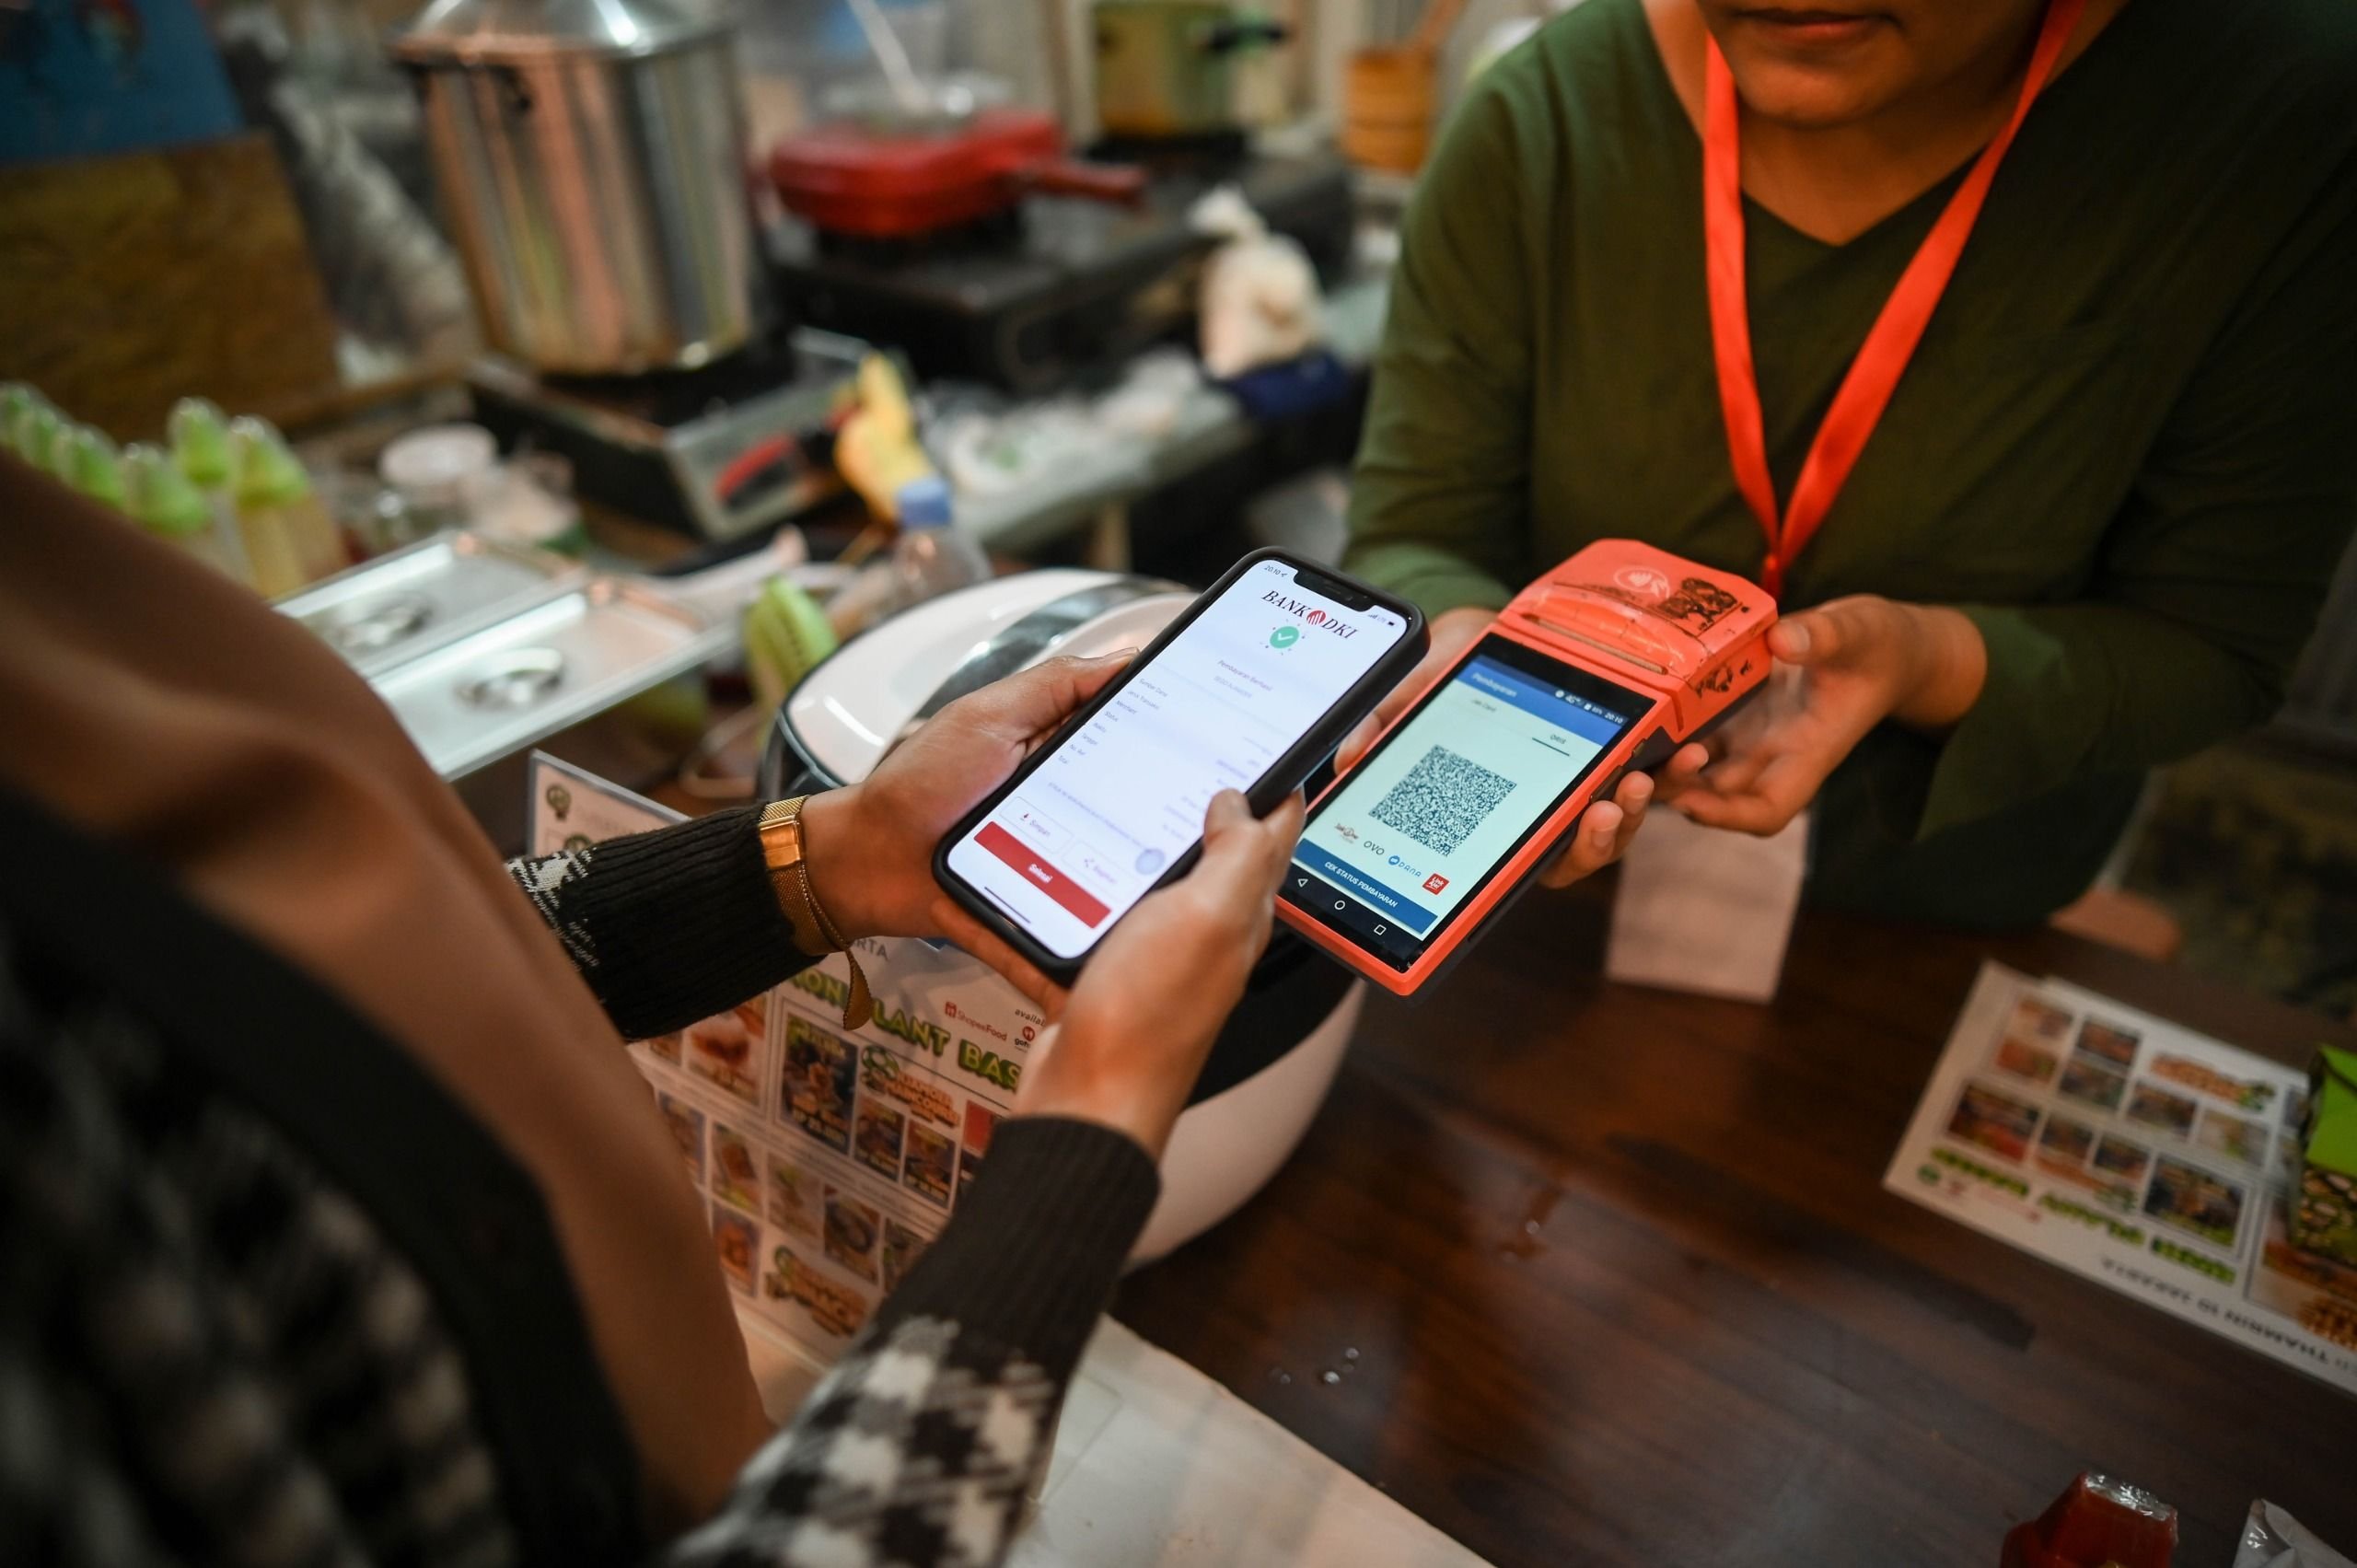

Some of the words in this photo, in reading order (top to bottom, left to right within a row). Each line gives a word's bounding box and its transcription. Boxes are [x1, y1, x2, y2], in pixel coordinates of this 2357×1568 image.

[1264, 565, 1282, 575] 20.10
[1260, 590, 1312, 618] BANK
[1321, 618, 1359, 639] DKI
[1364, 841, 1385, 855] OVO
[1324, 861, 1338, 873] CEK
[1336, 868, 1359, 885] STATUS
[1357, 879, 1399, 908] PEMBAYARAN
[956, 1009, 1008, 1042] ShopeeFood
[870, 997, 951, 1058] LANT
[958, 1038, 1023, 1096] BAS
